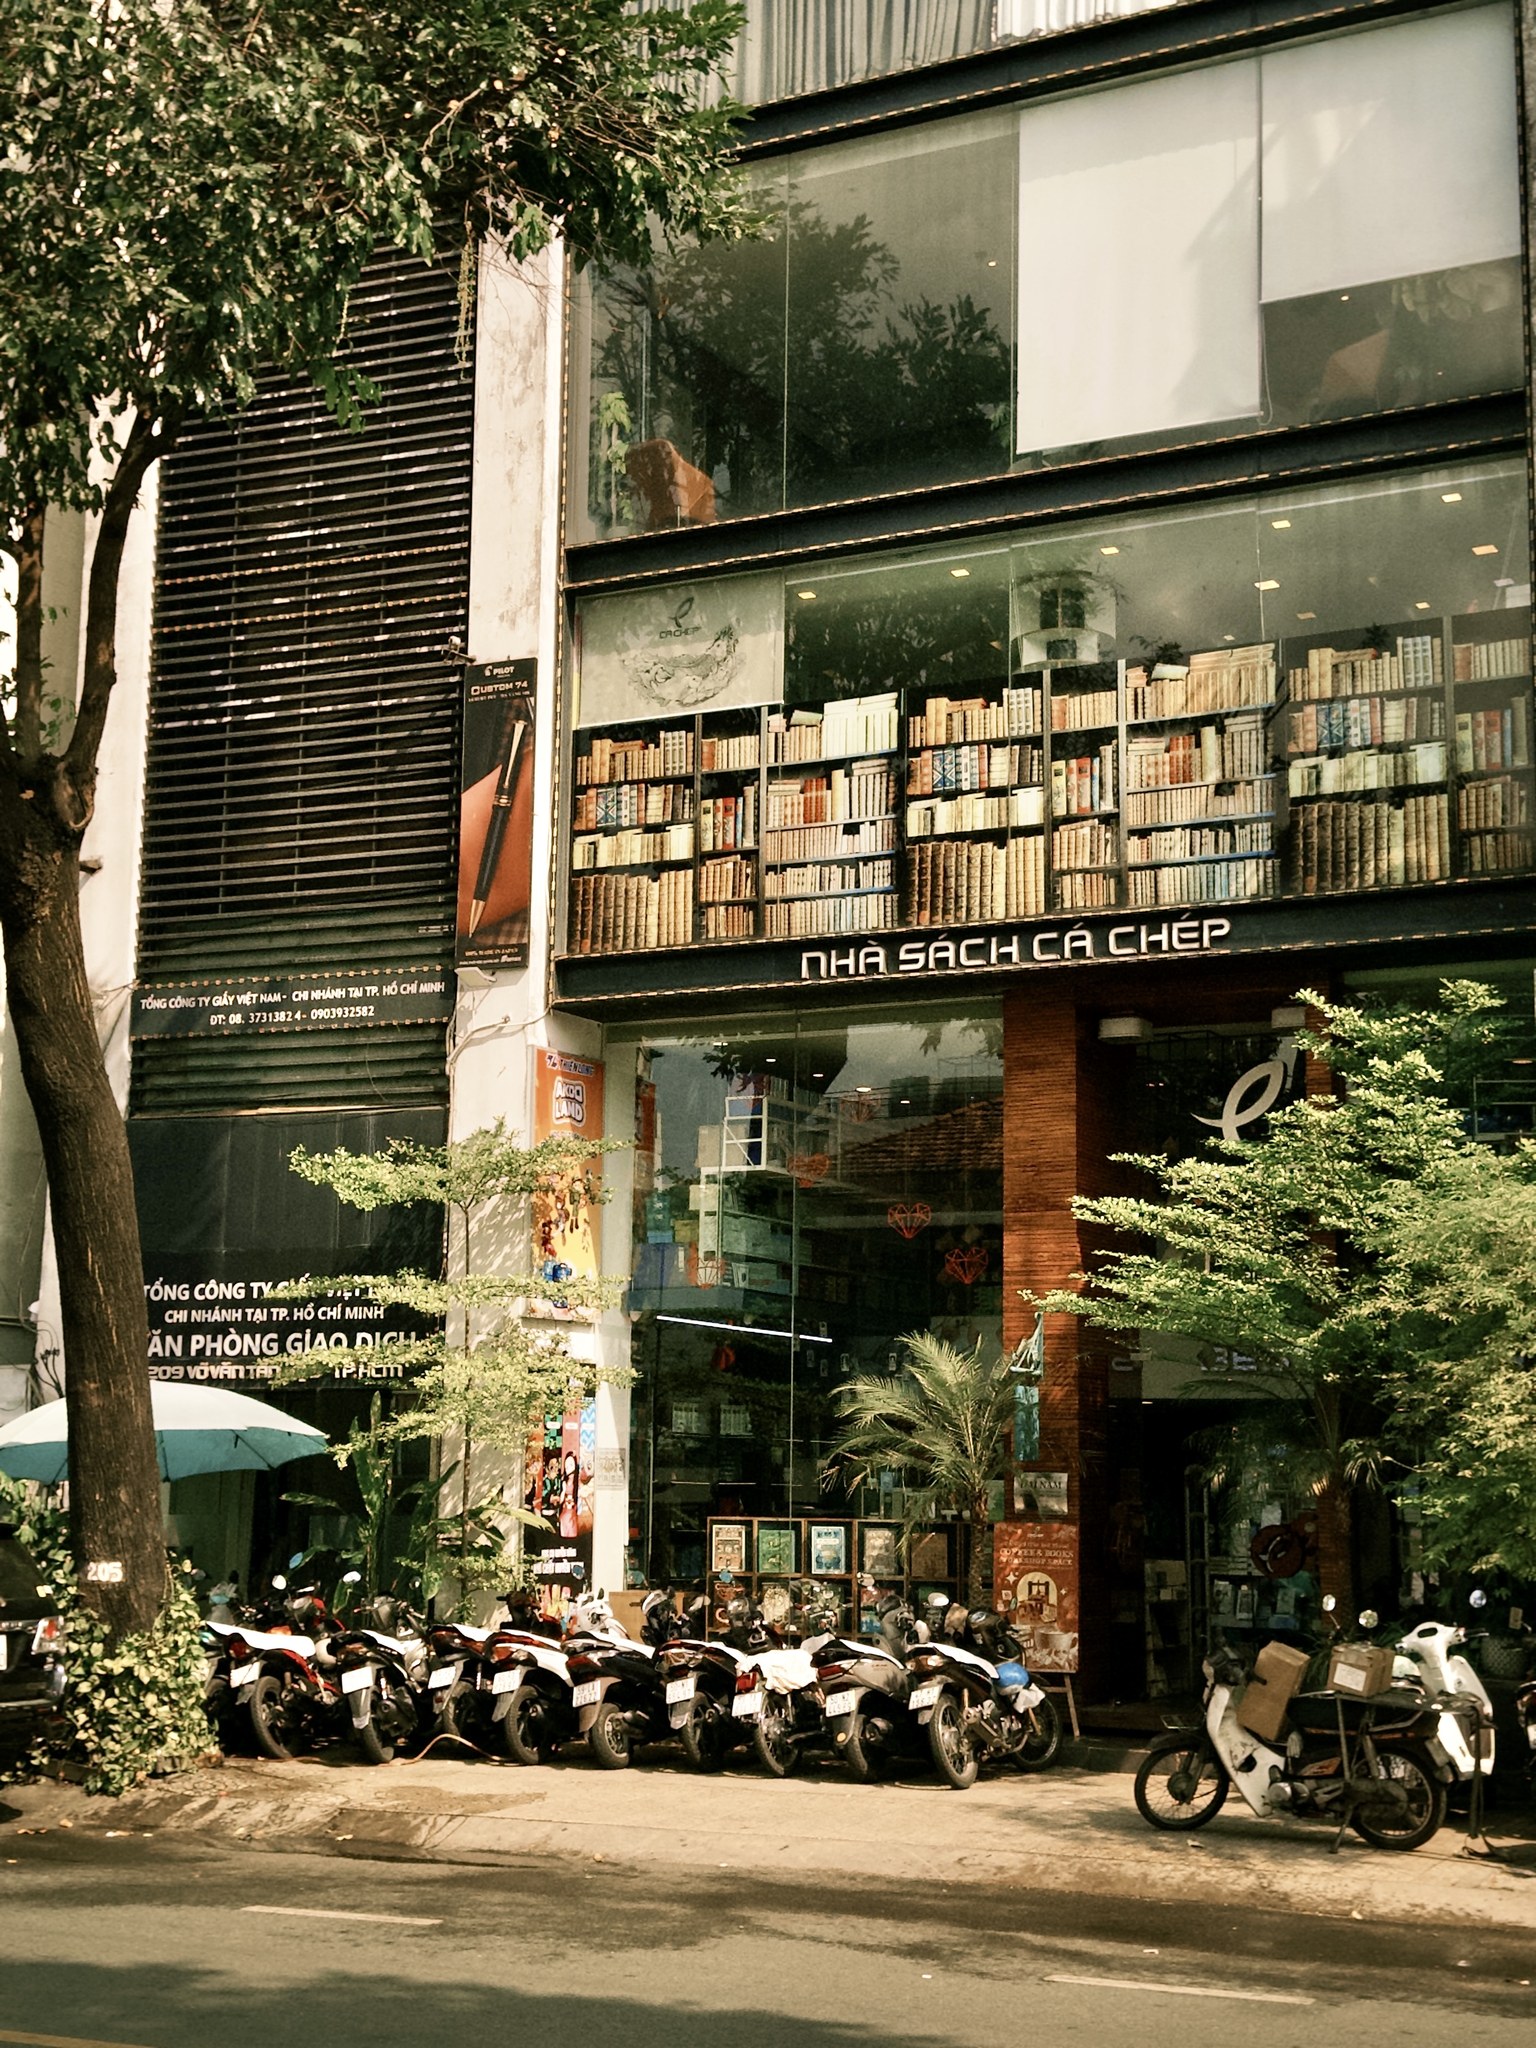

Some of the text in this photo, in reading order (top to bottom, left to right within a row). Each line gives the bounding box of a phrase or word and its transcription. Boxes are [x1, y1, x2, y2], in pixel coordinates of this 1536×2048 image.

[493, 666, 515, 675] PILOT
[471, 681, 529, 695] CUSTOM 74
[801, 912, 1232, 979] NHÀ SÁCH CÁ CHÉP
[168, 995, 196, 1009] CÔNG
[197, 996, 211, 1007] TY
[236, 991, 258, 1006] VIỆT
[292, 990, 309, 1002] CHI
[311, 987, 346, 1000] NHÁNH
[348, 987, 363, 999] TẠI
[365, 985, 380, 997] TP.
[400, 980, 418, 995] CHÍ
[419, 982, 445, 994] MINH
[228, 1012, 245, 1025] 08.
[310, 1006, 375, 1020] 0903932582
[555, 1100, 584, 1122] LAND
[194, 1279, 246, 1300] CÔNG
[250, 1282, 273, 1299] TY
[164, 1302, 385, 1324] CHI NHÁNH TẠI TP. HỒ CHÍ MINH
[147, 1329, 183, 1357] ĂN
[190, 1328, 279, 1357] PHÒNG
[148, 1365, 185, 1380] 209
[1044, 1549, 1074, 1558] BOOKS
[87, 1561, 123, 1582] 205
